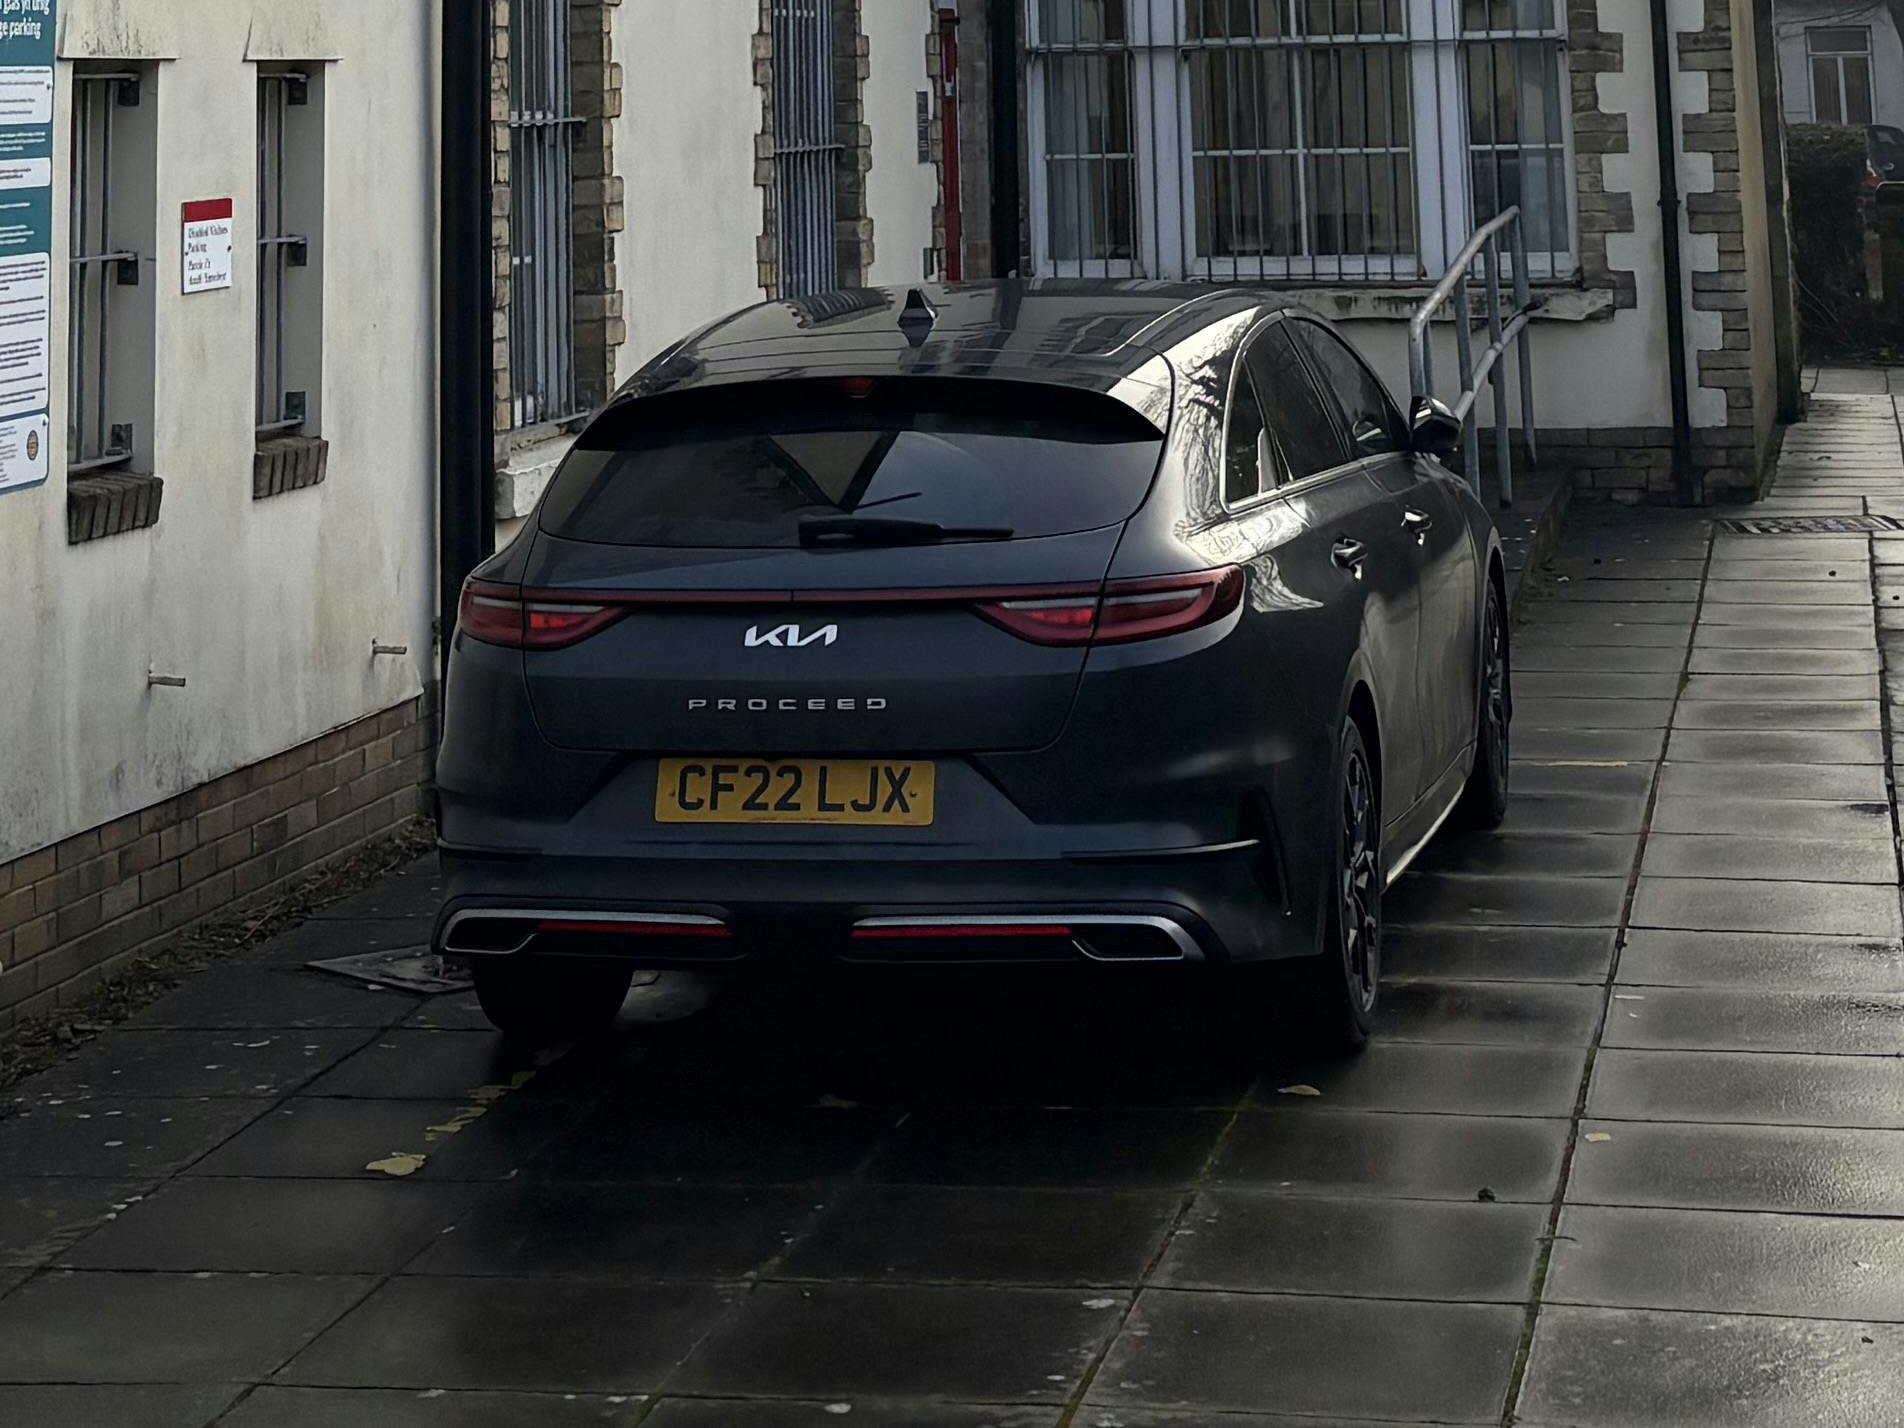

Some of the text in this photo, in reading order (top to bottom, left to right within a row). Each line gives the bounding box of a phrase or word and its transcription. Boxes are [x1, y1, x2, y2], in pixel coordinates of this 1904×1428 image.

[9, 17, 42, 40] parking
[745, 624, 837, 646] KIA
[688, 699, 887, 710] PROCEED
[678, 765, 912, 812] CF22 LJX
